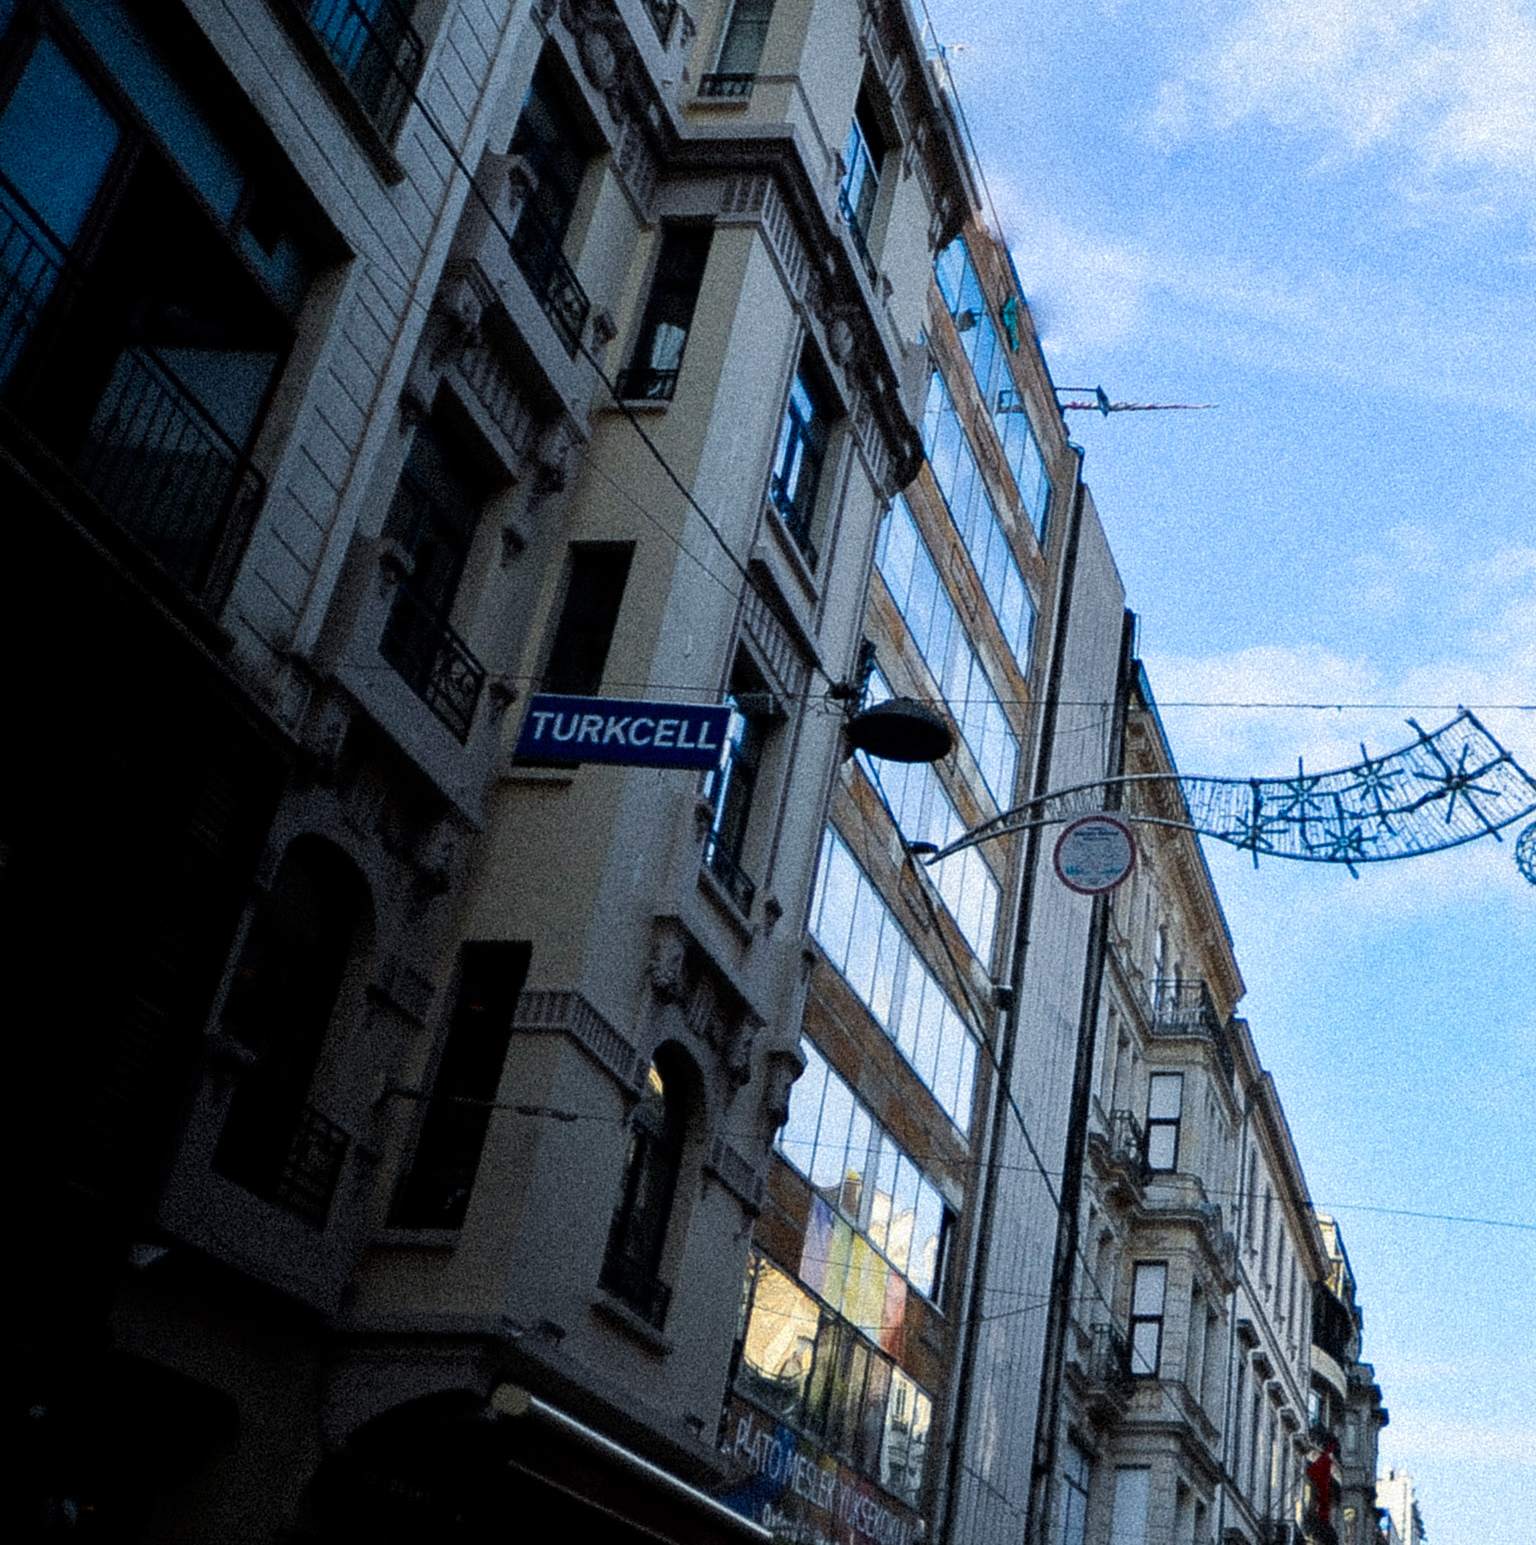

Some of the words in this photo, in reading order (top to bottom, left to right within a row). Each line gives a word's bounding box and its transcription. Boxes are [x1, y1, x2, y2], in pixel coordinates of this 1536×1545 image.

[532, 711, 717, 750] TURKCELL
[734, 1412, 784, 1480] PLATO
[782, 1448, 838, 1514] MESLEK
